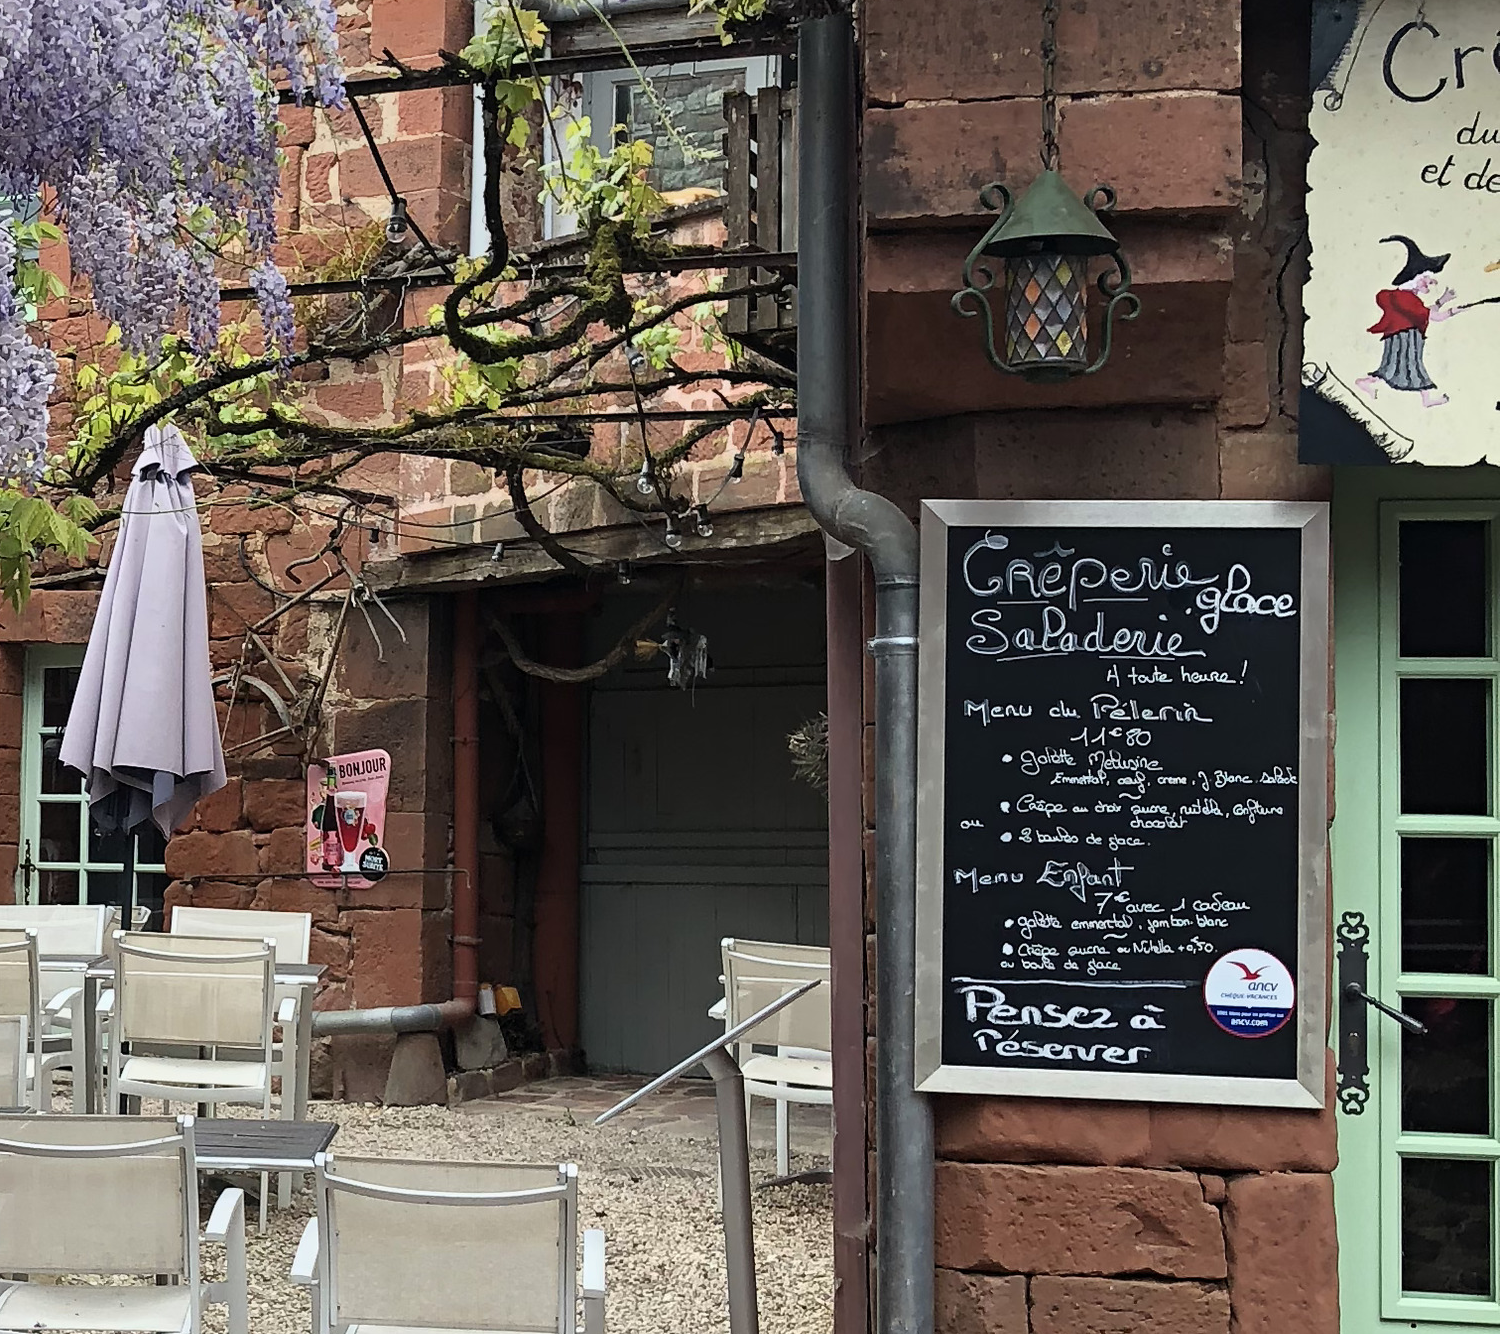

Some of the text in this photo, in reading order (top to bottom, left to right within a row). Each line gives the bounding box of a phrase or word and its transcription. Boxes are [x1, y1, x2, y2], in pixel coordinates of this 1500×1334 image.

[1456, 111, 1500, 145] du
[1420, 154, 1500, 194] et de
[1196, 564, 1297, 635] glace
[966, 606, 1206, 657] Saladerie
[1106, 663, 1120, 688] A
[1127, 665, 1173, 686] toute
[963, 698, 1032, 727] Menu
[1049, 699, 1081, 719] du
[339, 757, 387, 779] BONJOUR
[1020, 746, 1077, 776] galette
[1071, 805, 1089, 813] au
[1094, 800, 1122, 813] choix
[960, 816, 1189, 830] ou chocolat
[1036, 826, 1079, 844] boules
[1085, 832, 1103, 845] de
[953, 857, 1134, 903] Menu Enfant
[1125, 903, 1166, 914] avec
[1192, 892, 1251, 912] cadeau
[1017, 910, 1063, 940] galette
[1067, 945, 1111, 957] sucre
[1116, 946, 1131, 954] ou
[1132, 938, 1175, 955] Nutella
[1000, 957, 1122, 976] ou boule de glace
[1247, 981, 1279, 992] ancv
[954, 984, 1167, 1029] Pensez à
[972, 1028, 1152, 1065] réserver
